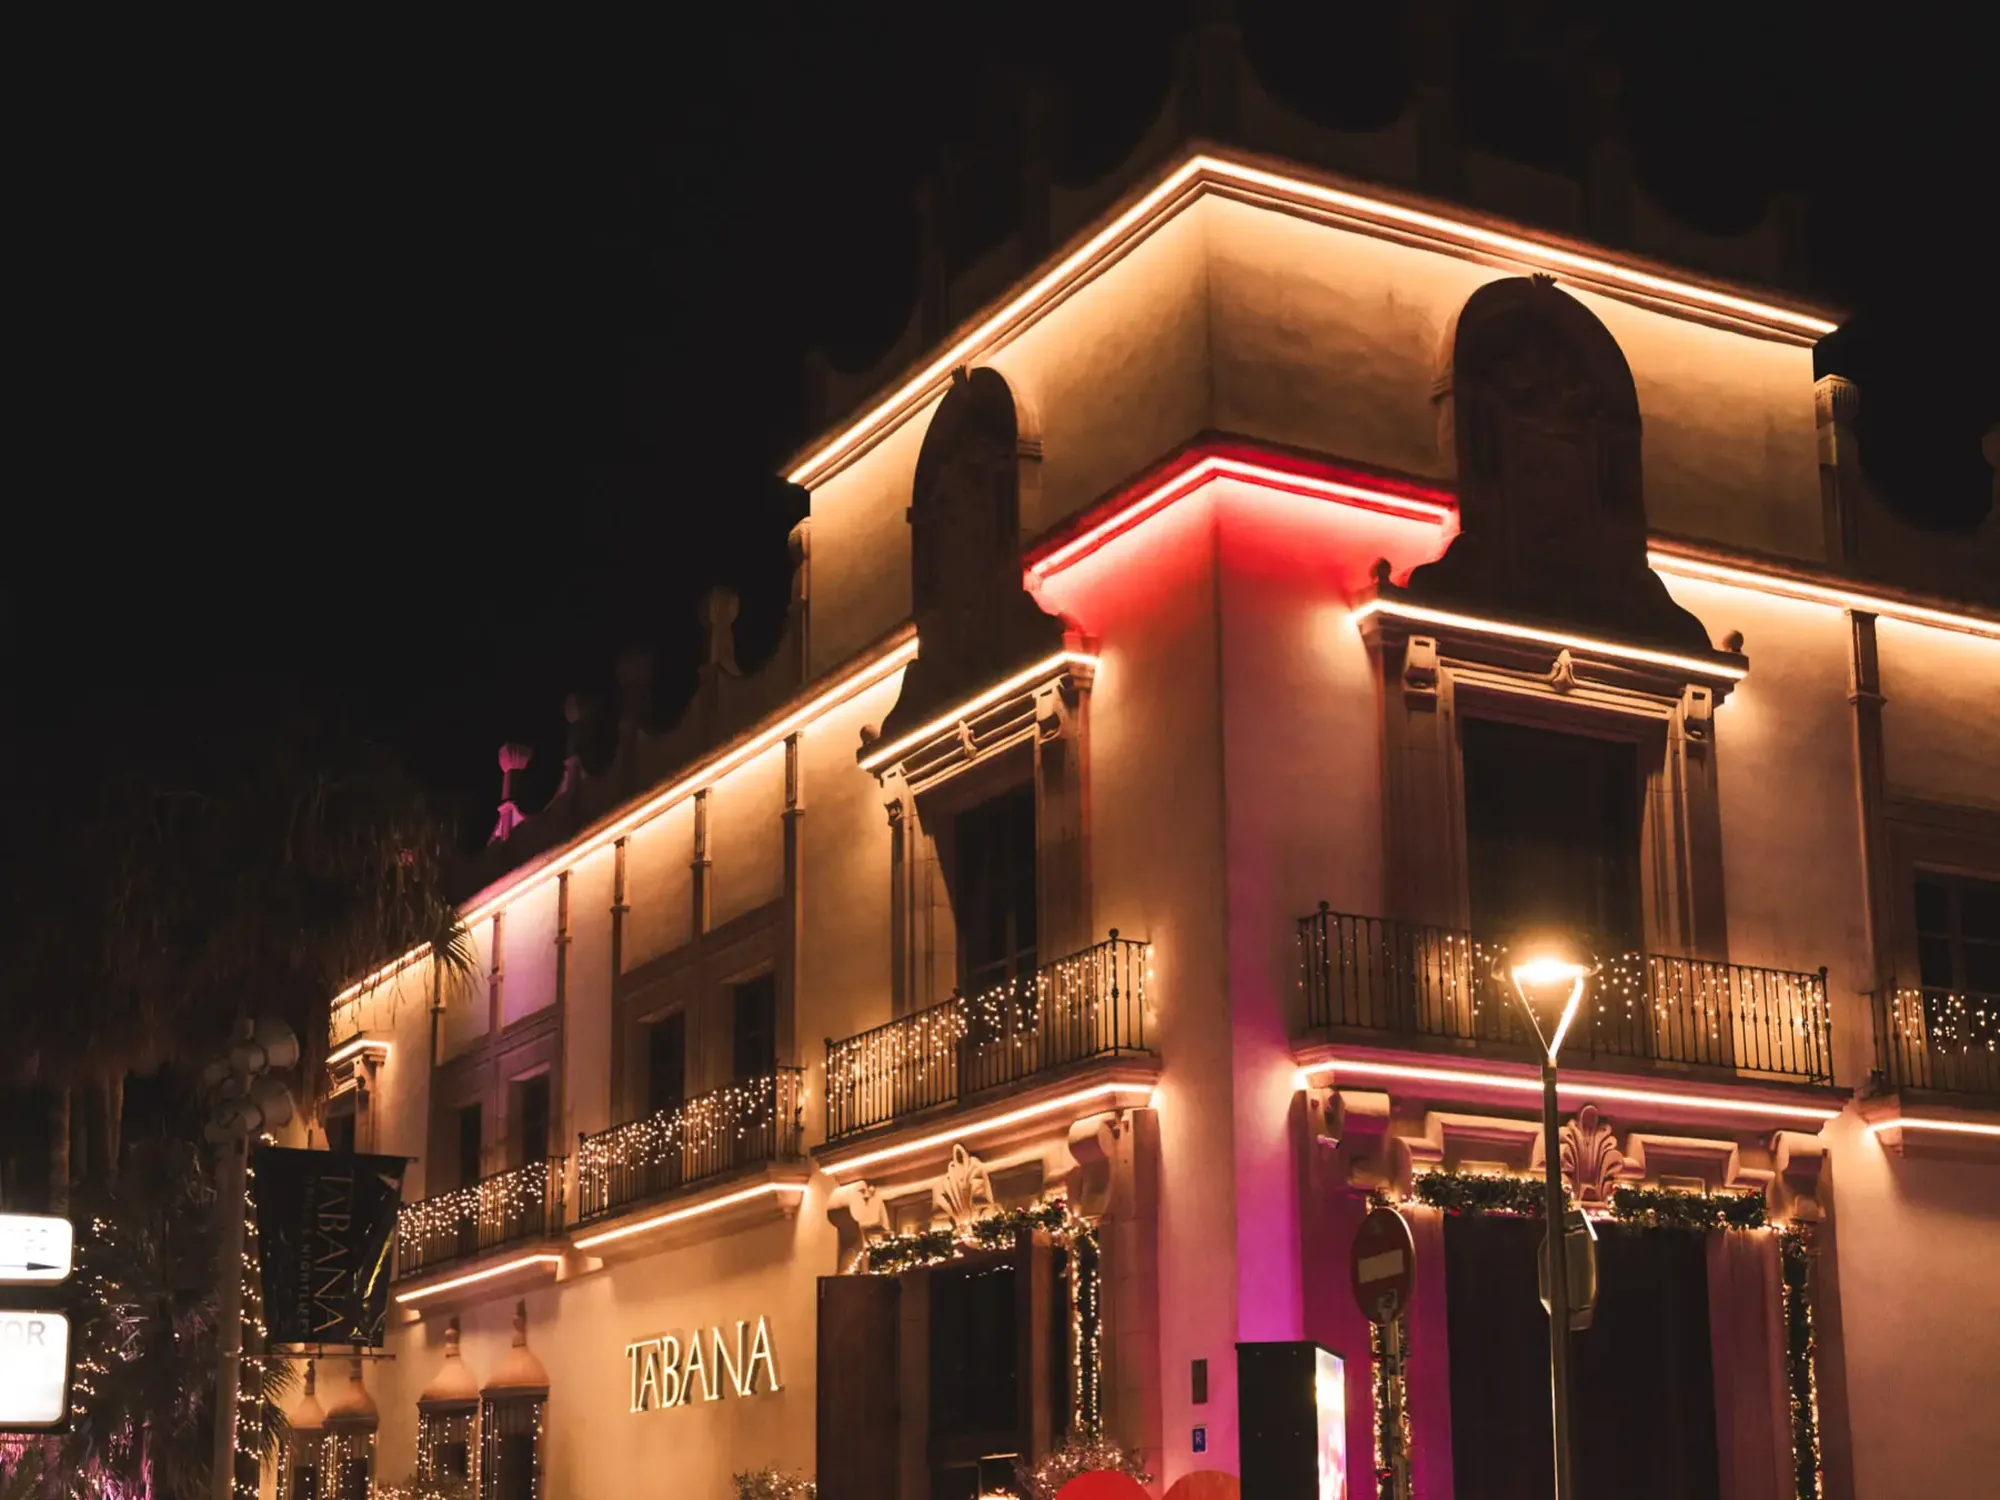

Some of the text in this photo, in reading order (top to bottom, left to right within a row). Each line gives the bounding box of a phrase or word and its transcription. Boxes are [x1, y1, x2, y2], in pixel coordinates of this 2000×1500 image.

[314, 1169, 354, 1332] TABANA
[0, 1319, 46, 1347] OR
[625, 1314, 779, 1413] TABANA
